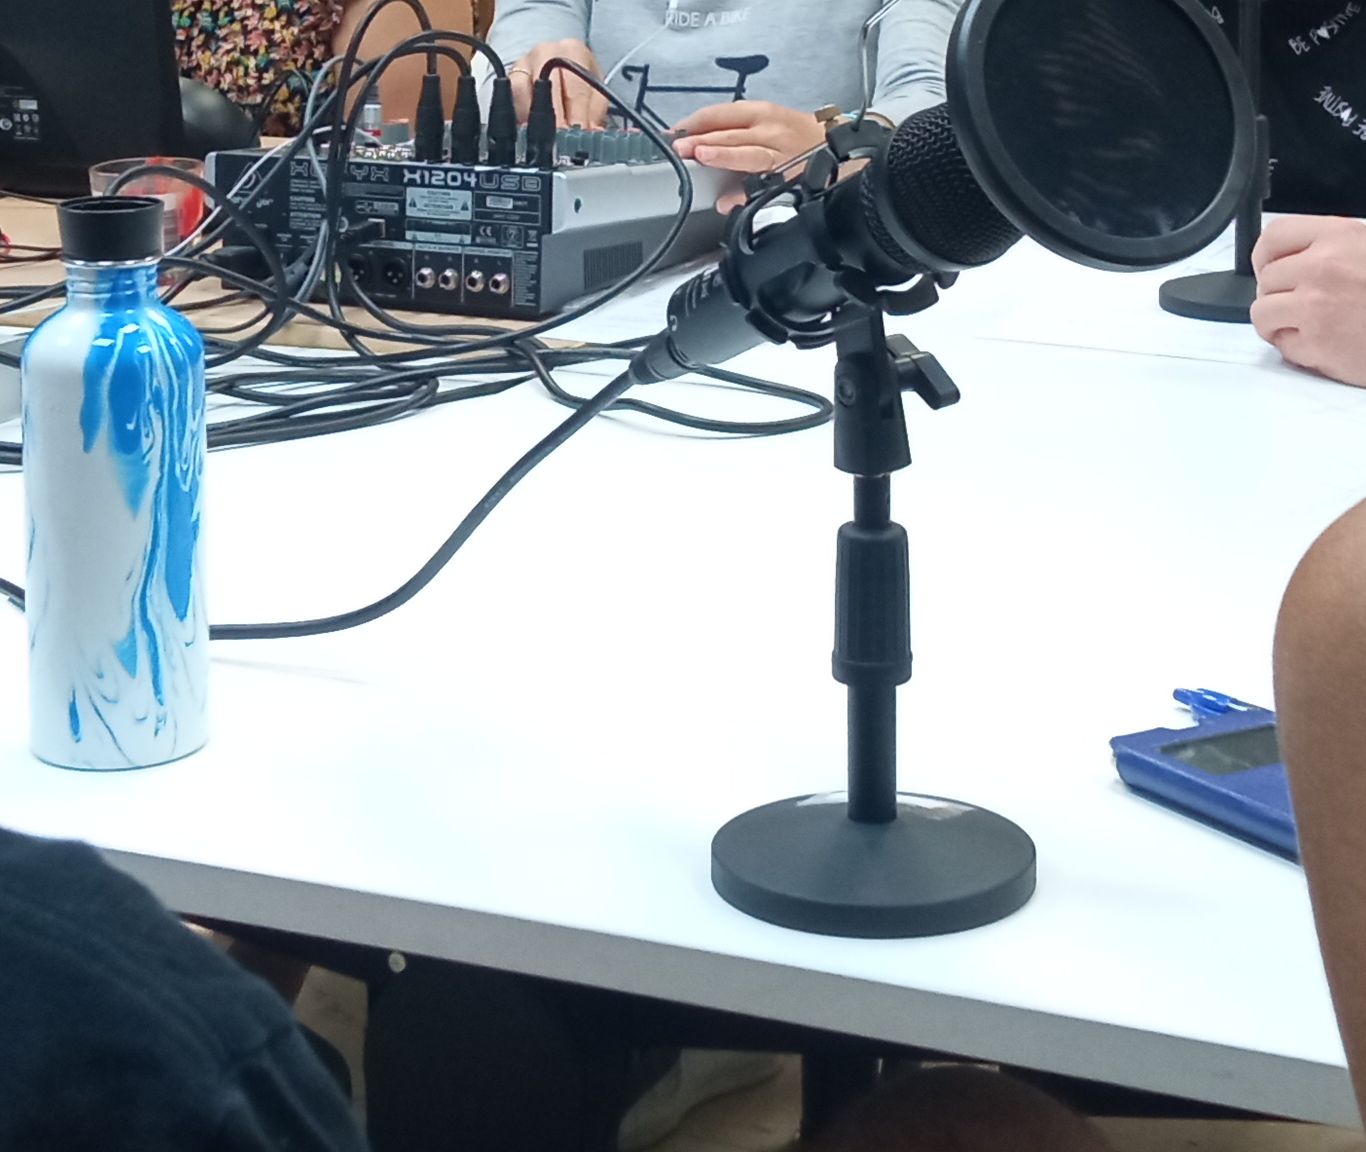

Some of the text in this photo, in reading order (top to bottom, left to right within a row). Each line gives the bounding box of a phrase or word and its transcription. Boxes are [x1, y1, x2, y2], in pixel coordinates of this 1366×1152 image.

[665, 6, 753, 28] RIDE A BIKE
[1288, 35, 1311, 56] BE
